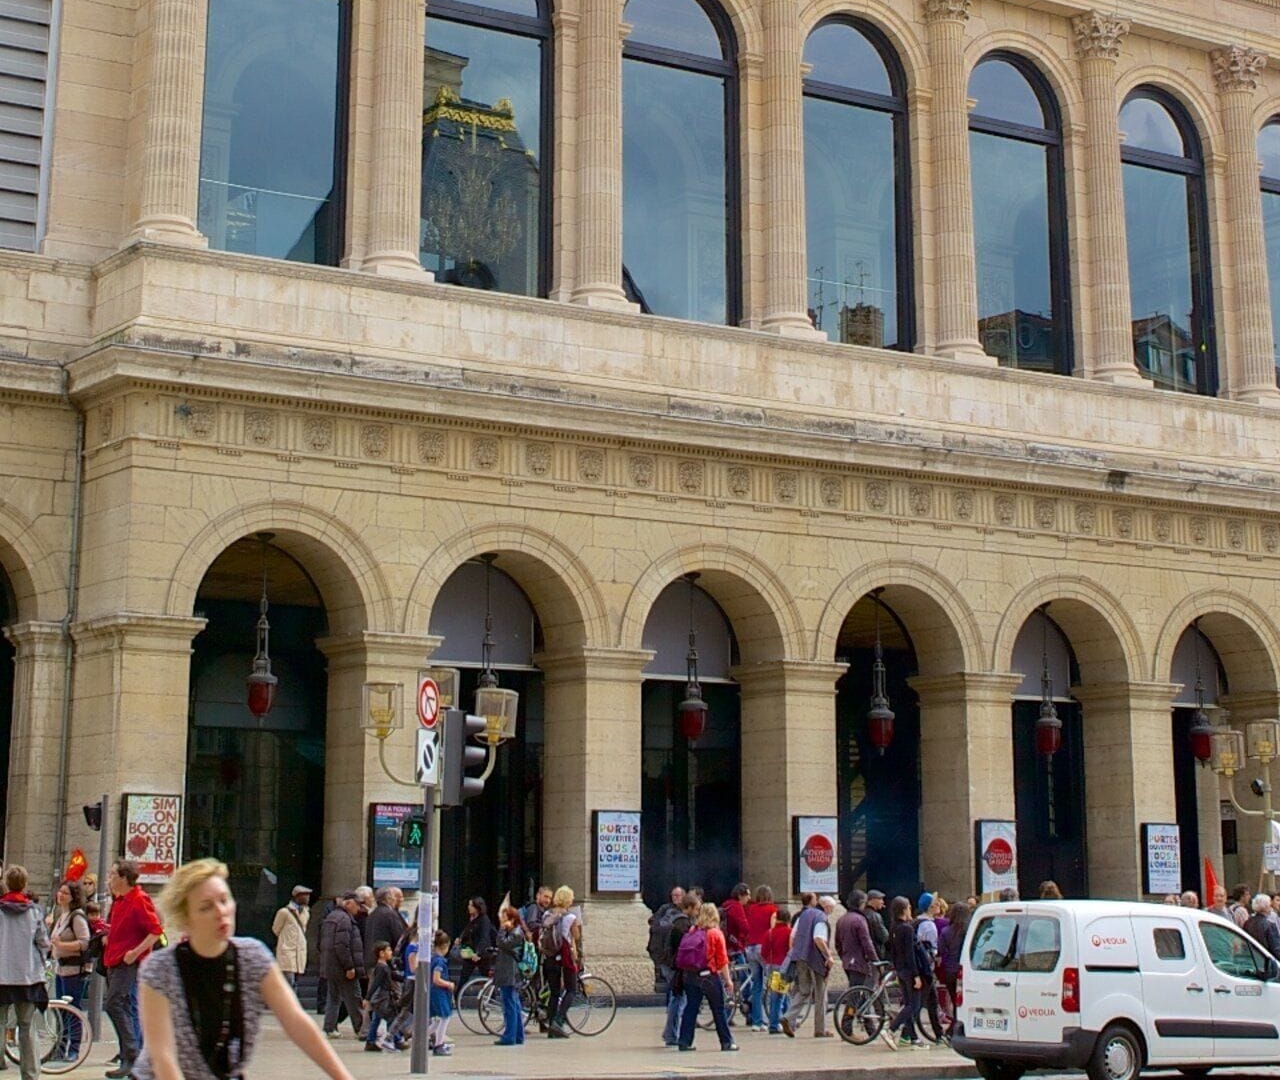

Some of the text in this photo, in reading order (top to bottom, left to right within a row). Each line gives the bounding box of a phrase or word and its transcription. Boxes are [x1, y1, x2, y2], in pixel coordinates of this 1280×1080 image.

[152, 798, 177, 810] SIM
[154, 810, 178, 823] ON
[128, 822, 175, 836] BOCCA
[147, 835, 175, 848] NEG
[154, 848, 175, 861] RA
[1101, 936, 1128, 945] VEOLIA
[1029, 1008, 1056, 1017] VEOLIA
